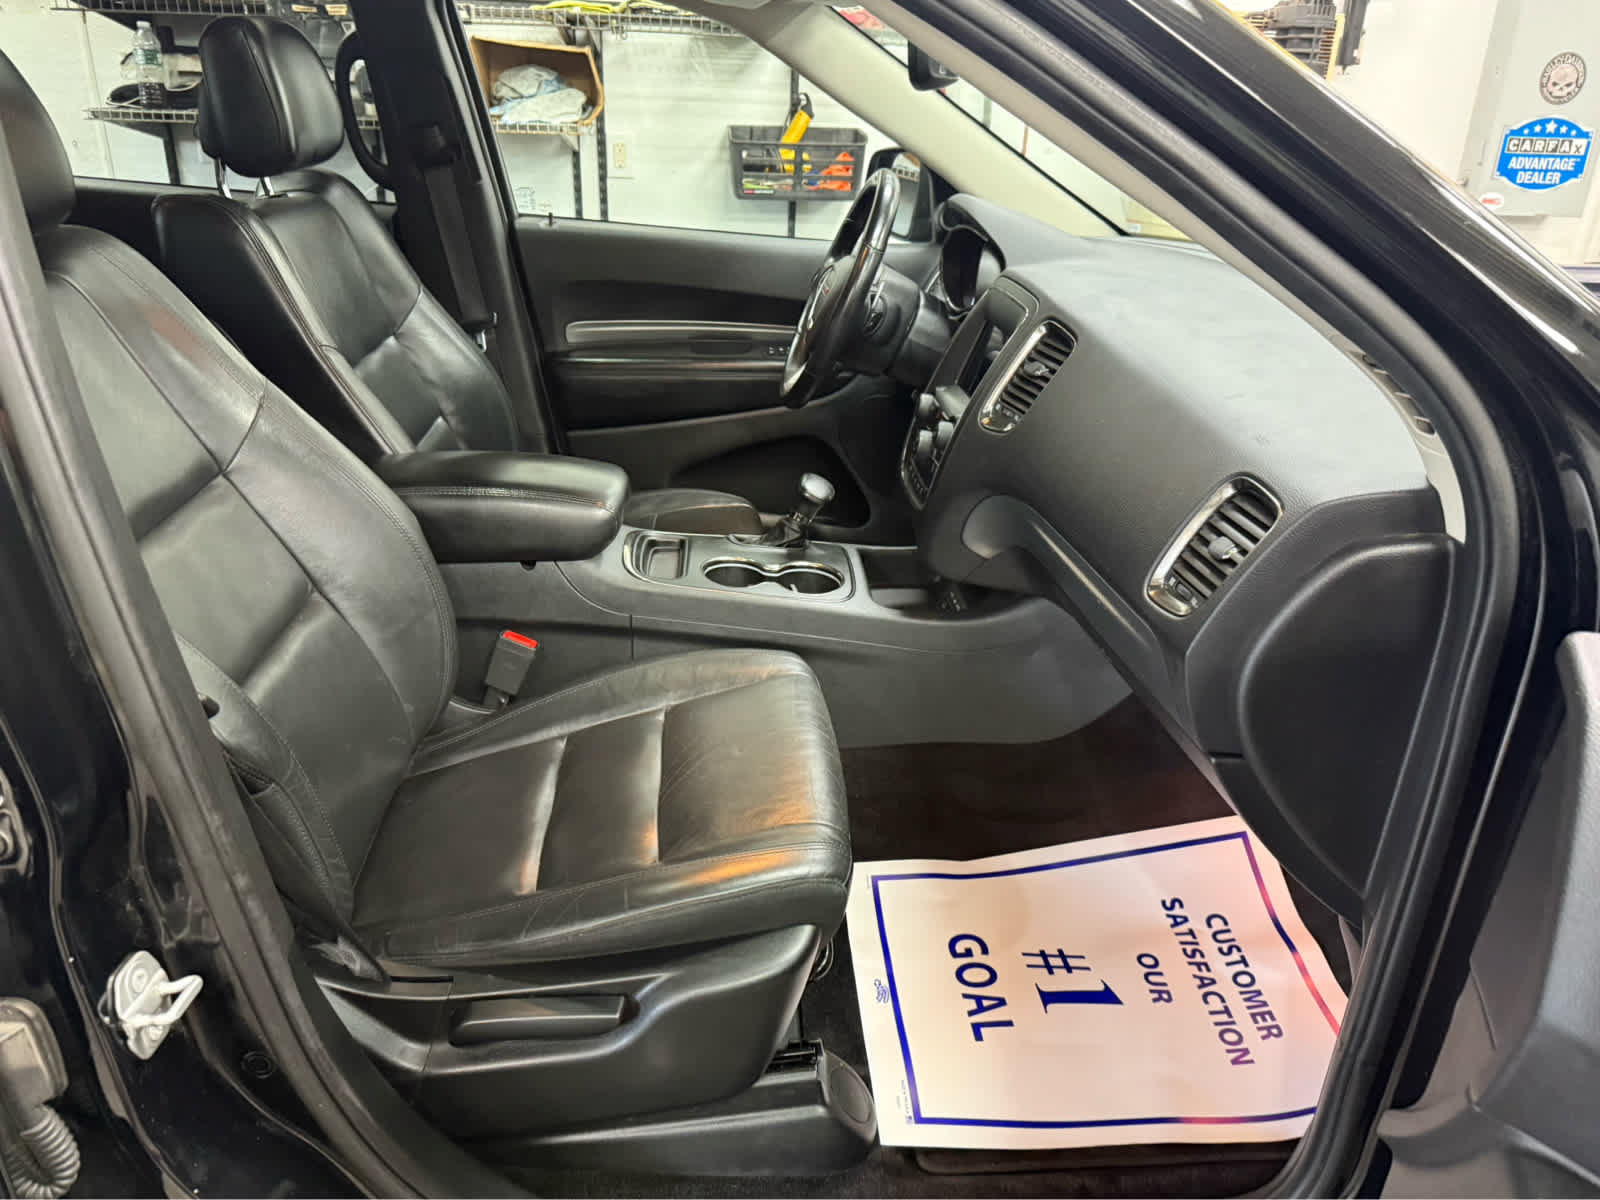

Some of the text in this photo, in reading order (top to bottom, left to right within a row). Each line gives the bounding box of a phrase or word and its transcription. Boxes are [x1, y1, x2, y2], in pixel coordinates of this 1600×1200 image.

[1506, 138, 1583, 153] CARFAX
[1516, 171, 1562, 184] DEALER
[948, 933, 1015, 1042] GOAL
[1021, 948, 1125, 1014] #1
[1136, 953, 1174, 1004] OUR
[1160, 897, 1256, 1066] SATISFACTION
[1205, 913, 1283, 1041] CUSTOMER
